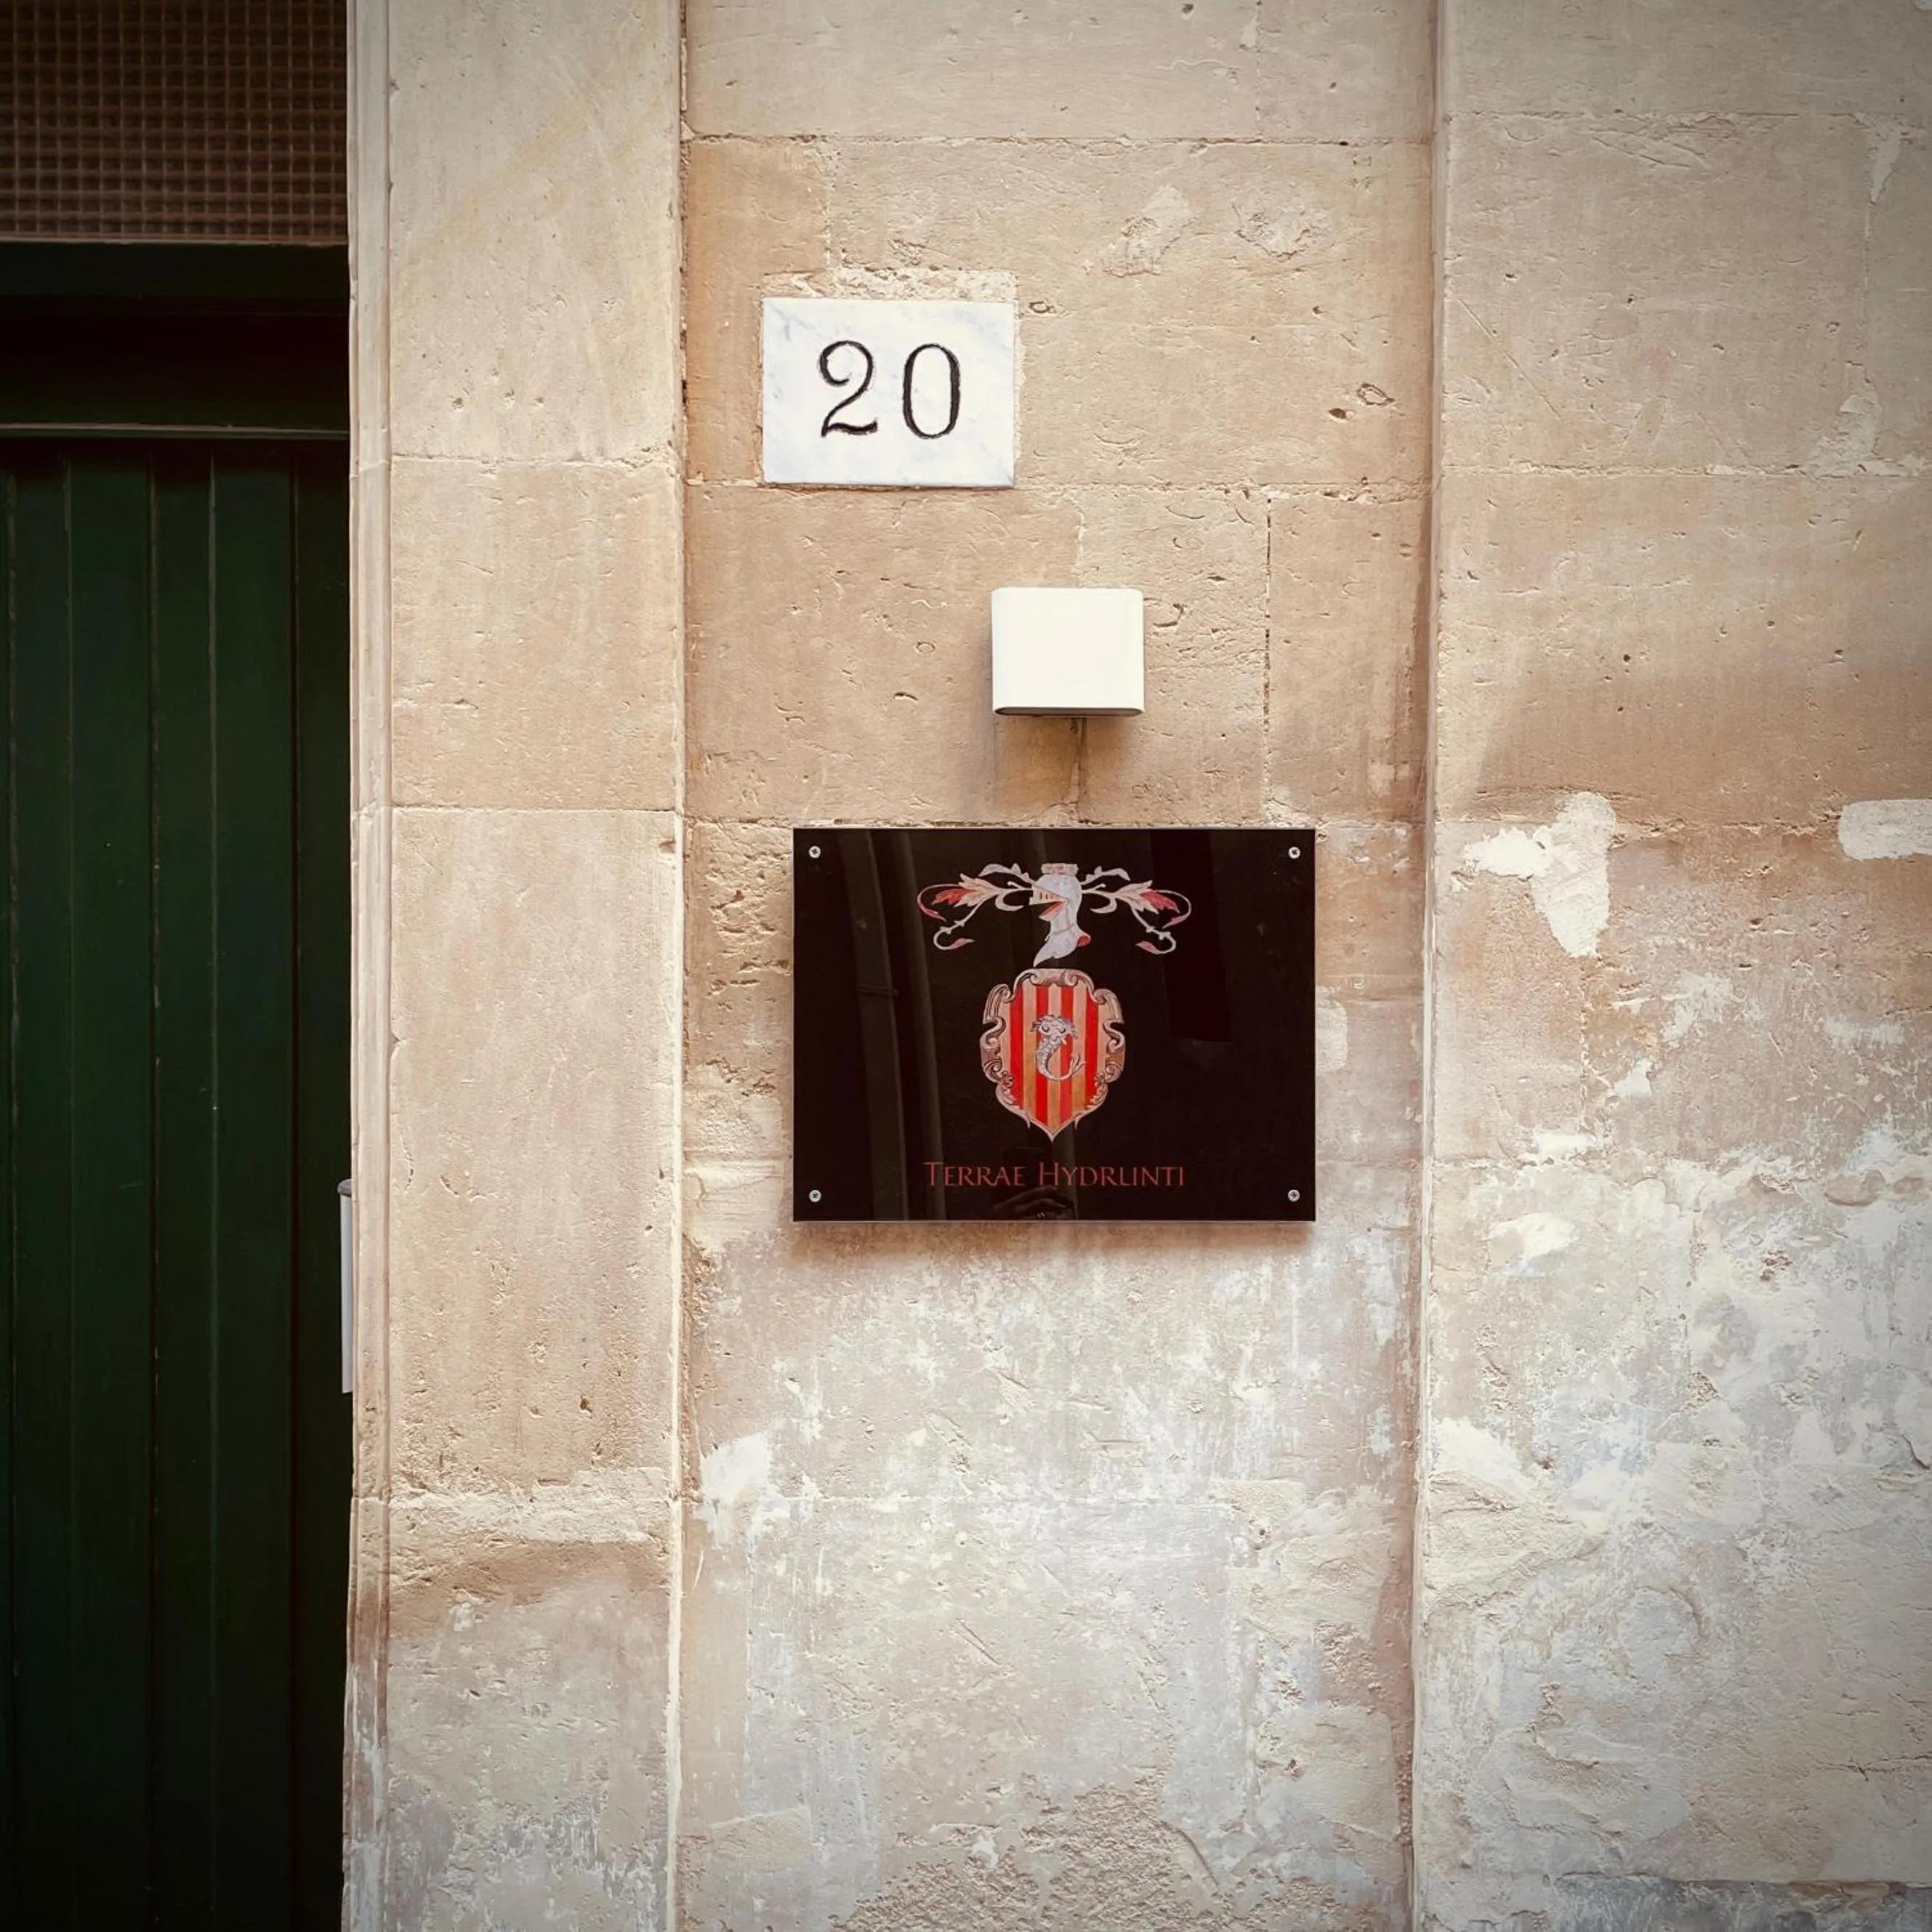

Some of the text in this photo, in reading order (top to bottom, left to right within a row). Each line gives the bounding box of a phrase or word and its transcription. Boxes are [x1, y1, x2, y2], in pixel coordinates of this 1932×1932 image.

[818, 339, 961, 440] 20
[923, 1161, 1184, 1186] TERRAE HYDRUNTI
